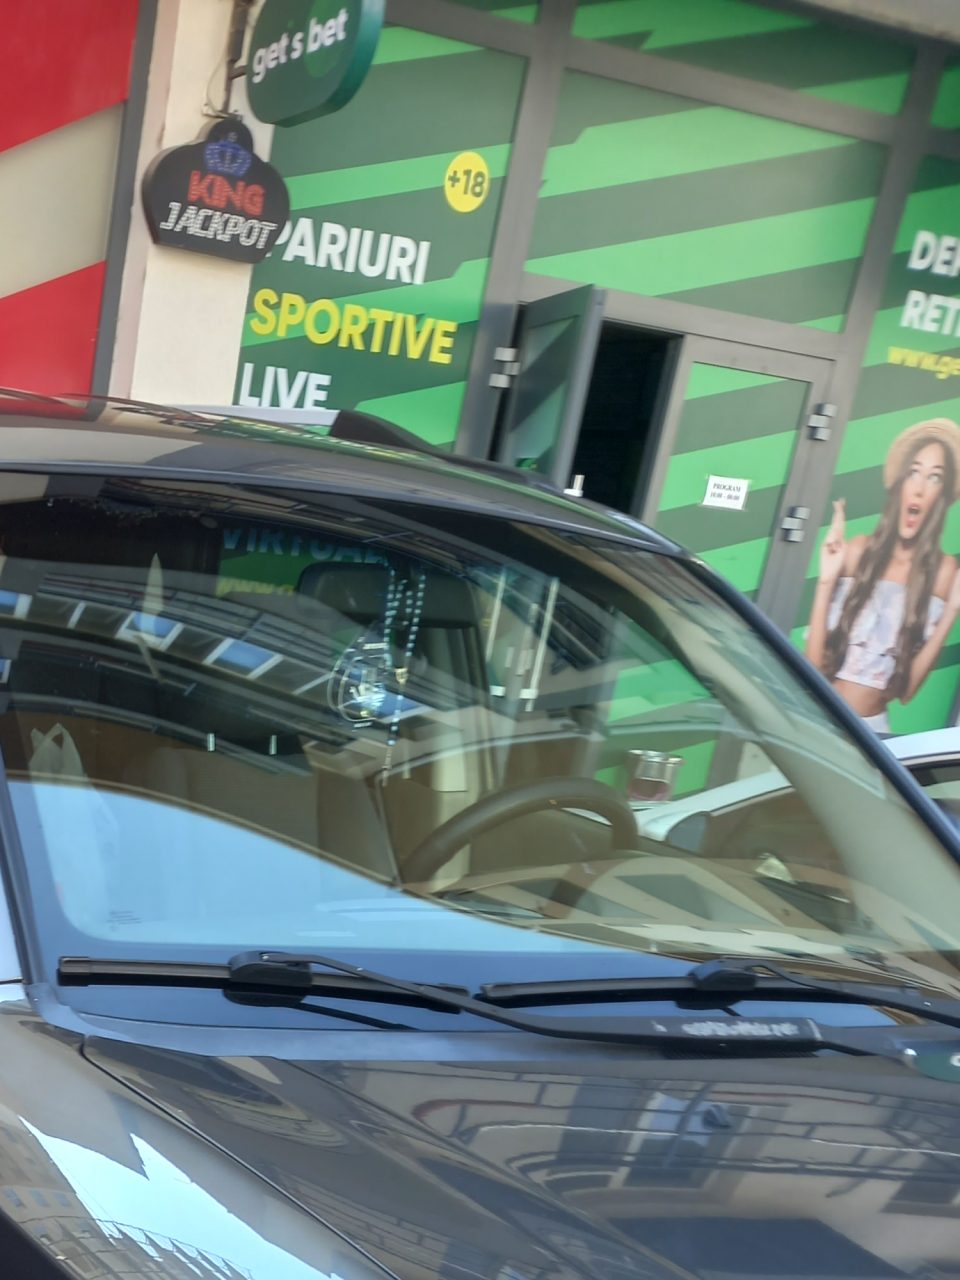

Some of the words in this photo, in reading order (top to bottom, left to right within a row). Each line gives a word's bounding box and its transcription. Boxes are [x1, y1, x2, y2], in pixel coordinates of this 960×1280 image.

[306, 8, 349, 53] bet
[188, 170, 266, 216] KING
[447, 169, 487, 199] +18
[160, 202, 278, 249] JACKPOT
[249, 288, 458, 364] SPORTIVE
[900, 289, 960, 338] RET
[239, 362, 332, 410] LIVE
